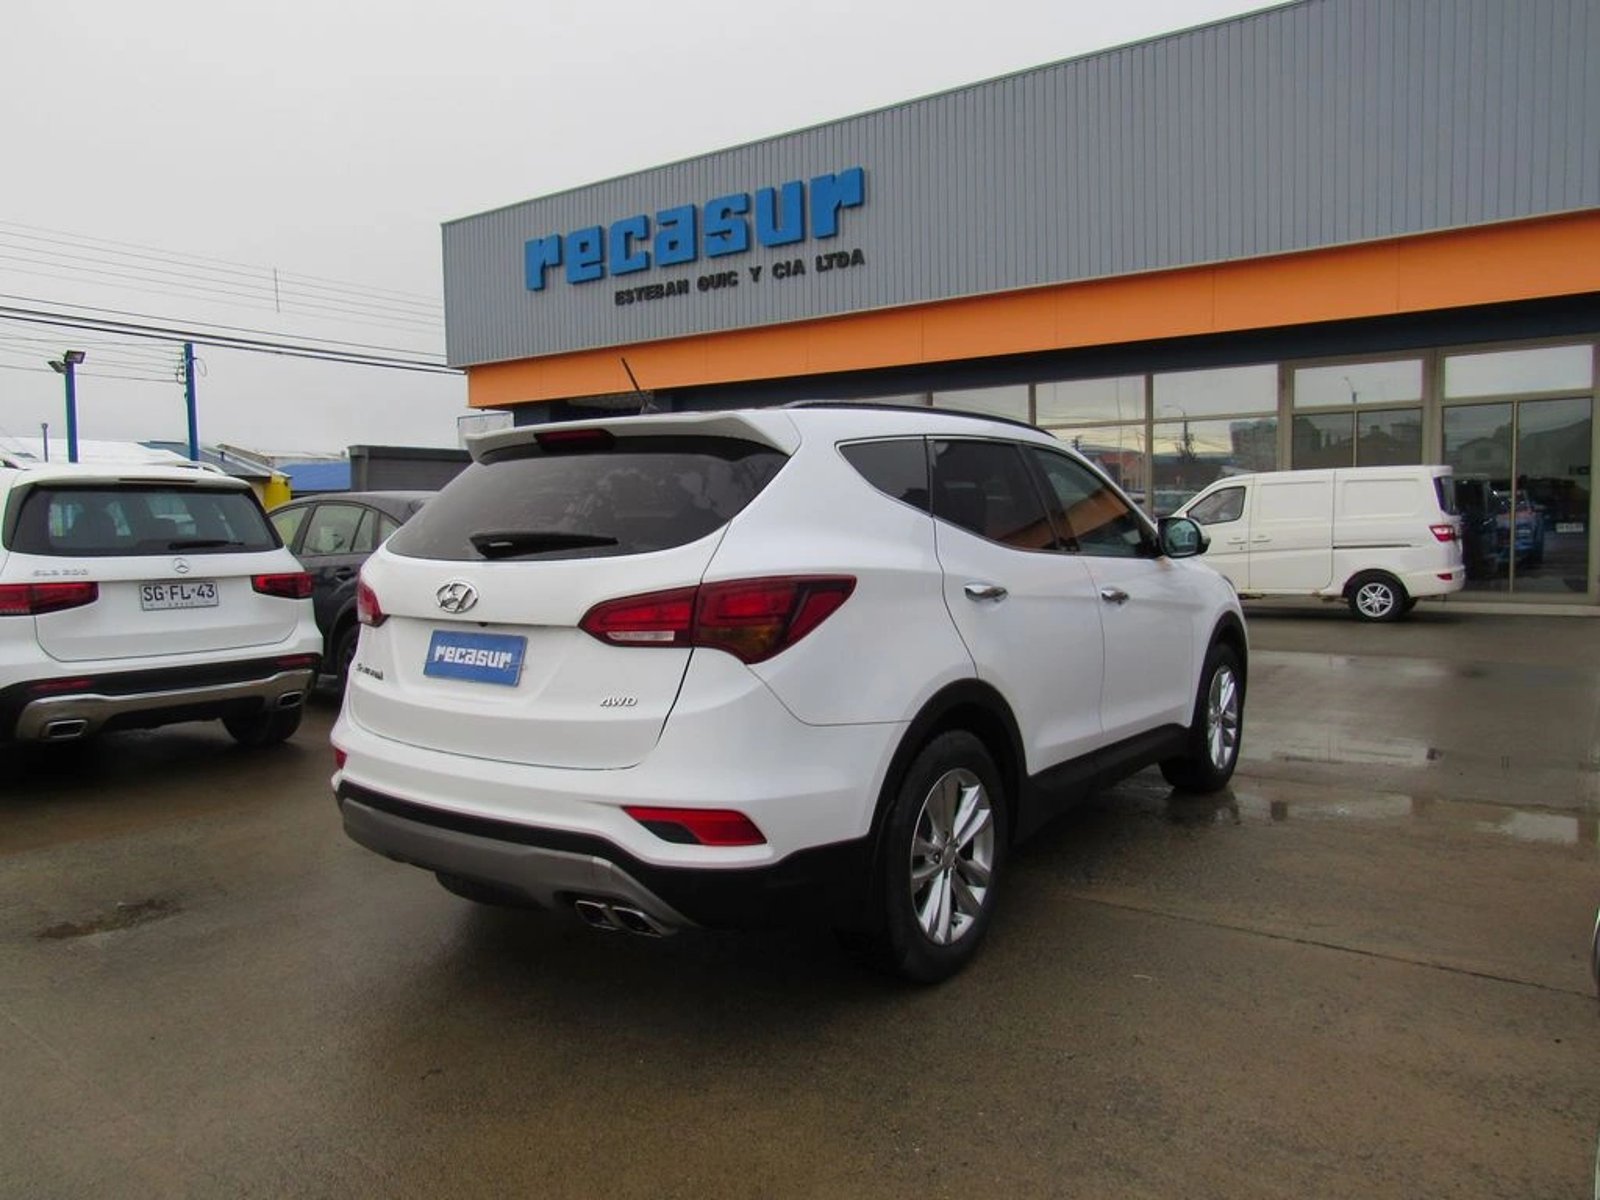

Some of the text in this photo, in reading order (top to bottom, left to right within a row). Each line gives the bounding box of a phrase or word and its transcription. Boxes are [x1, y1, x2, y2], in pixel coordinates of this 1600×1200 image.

[524, 167, 865, 292] recasur
[614, 279, 690, 306] ESTEBAN
[749, 266, 763, 283] Y
[771, 259, 806, 280] CIA
[815, 249, 866, 273] LTDA
[434, 645, 513, 669] recasur
[600, 696, 638, 708] AWD
